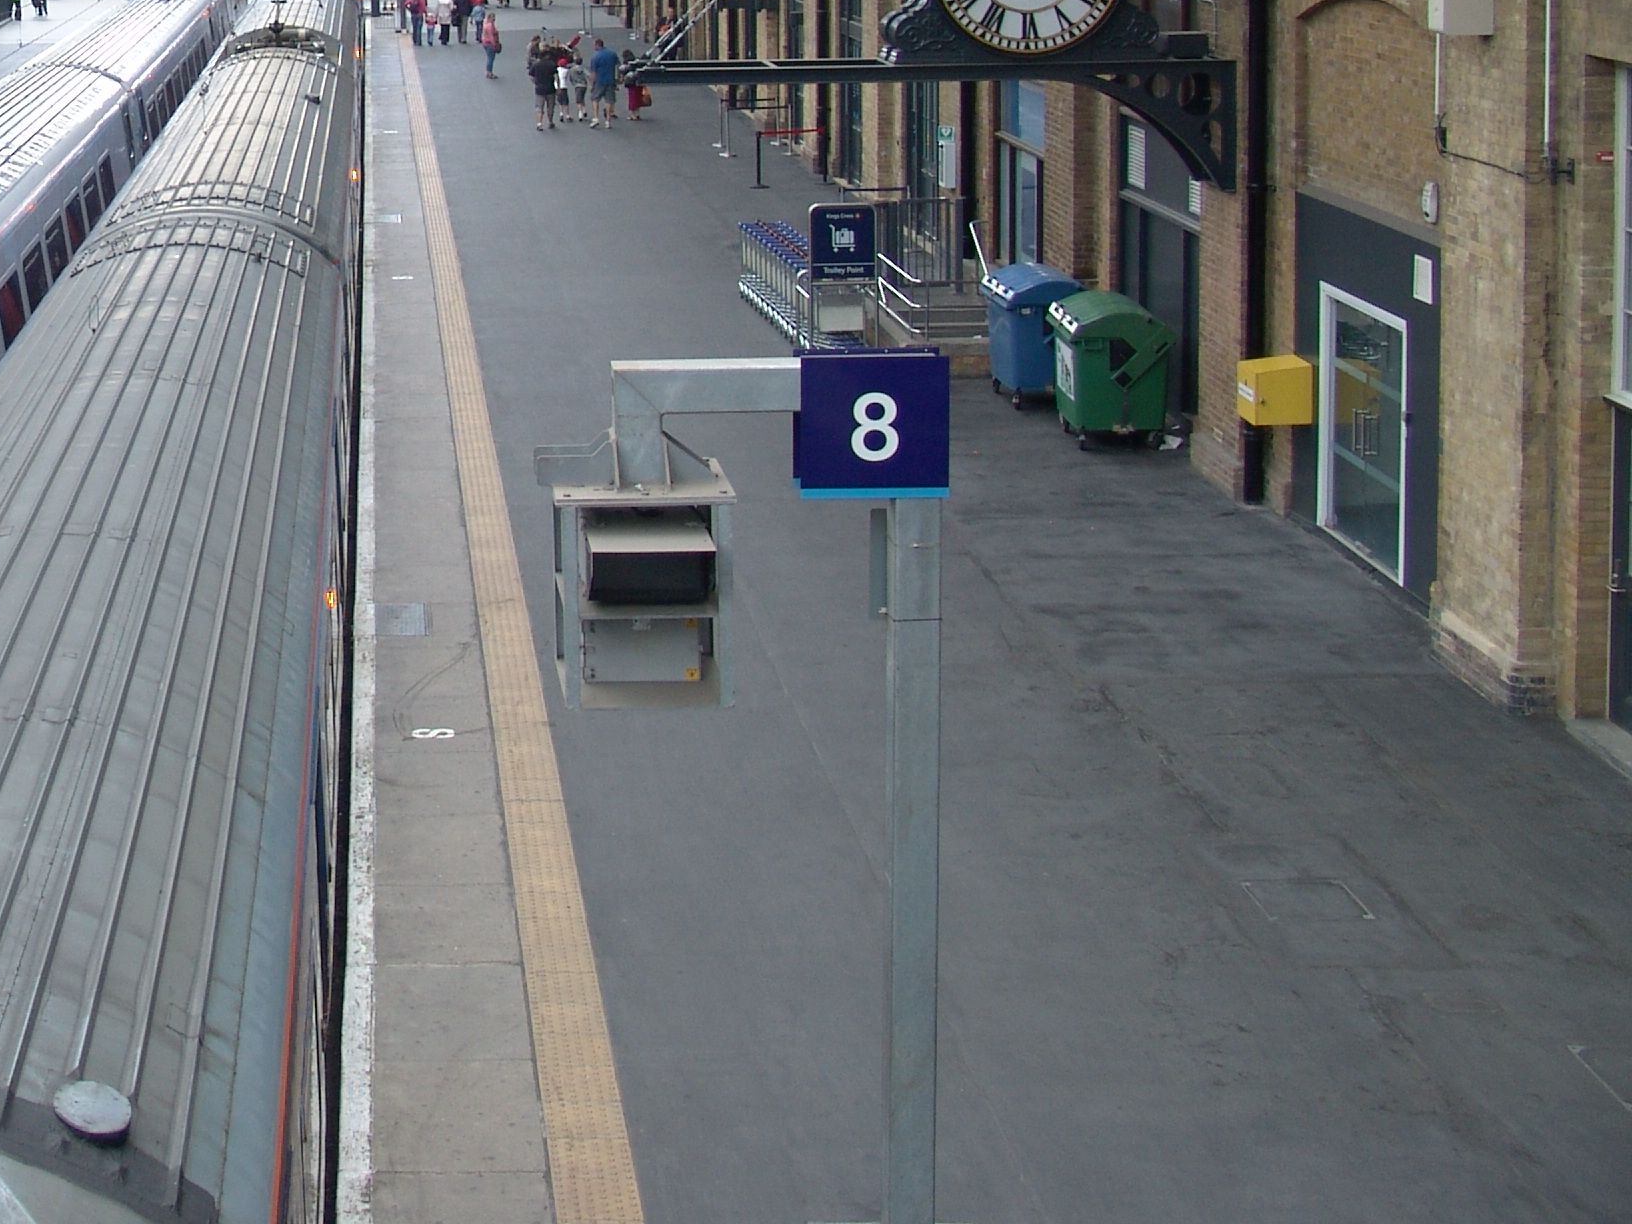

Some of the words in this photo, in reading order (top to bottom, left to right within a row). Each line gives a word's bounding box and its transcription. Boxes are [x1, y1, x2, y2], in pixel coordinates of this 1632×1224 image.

[979, 3, 1006, 33] VII
[1021, 13, 1040, 40] VI
[1054, 5, 1077, 31] V
[823, 267, 845, 276] Trolley
[851, 392, 899, 462] 8
